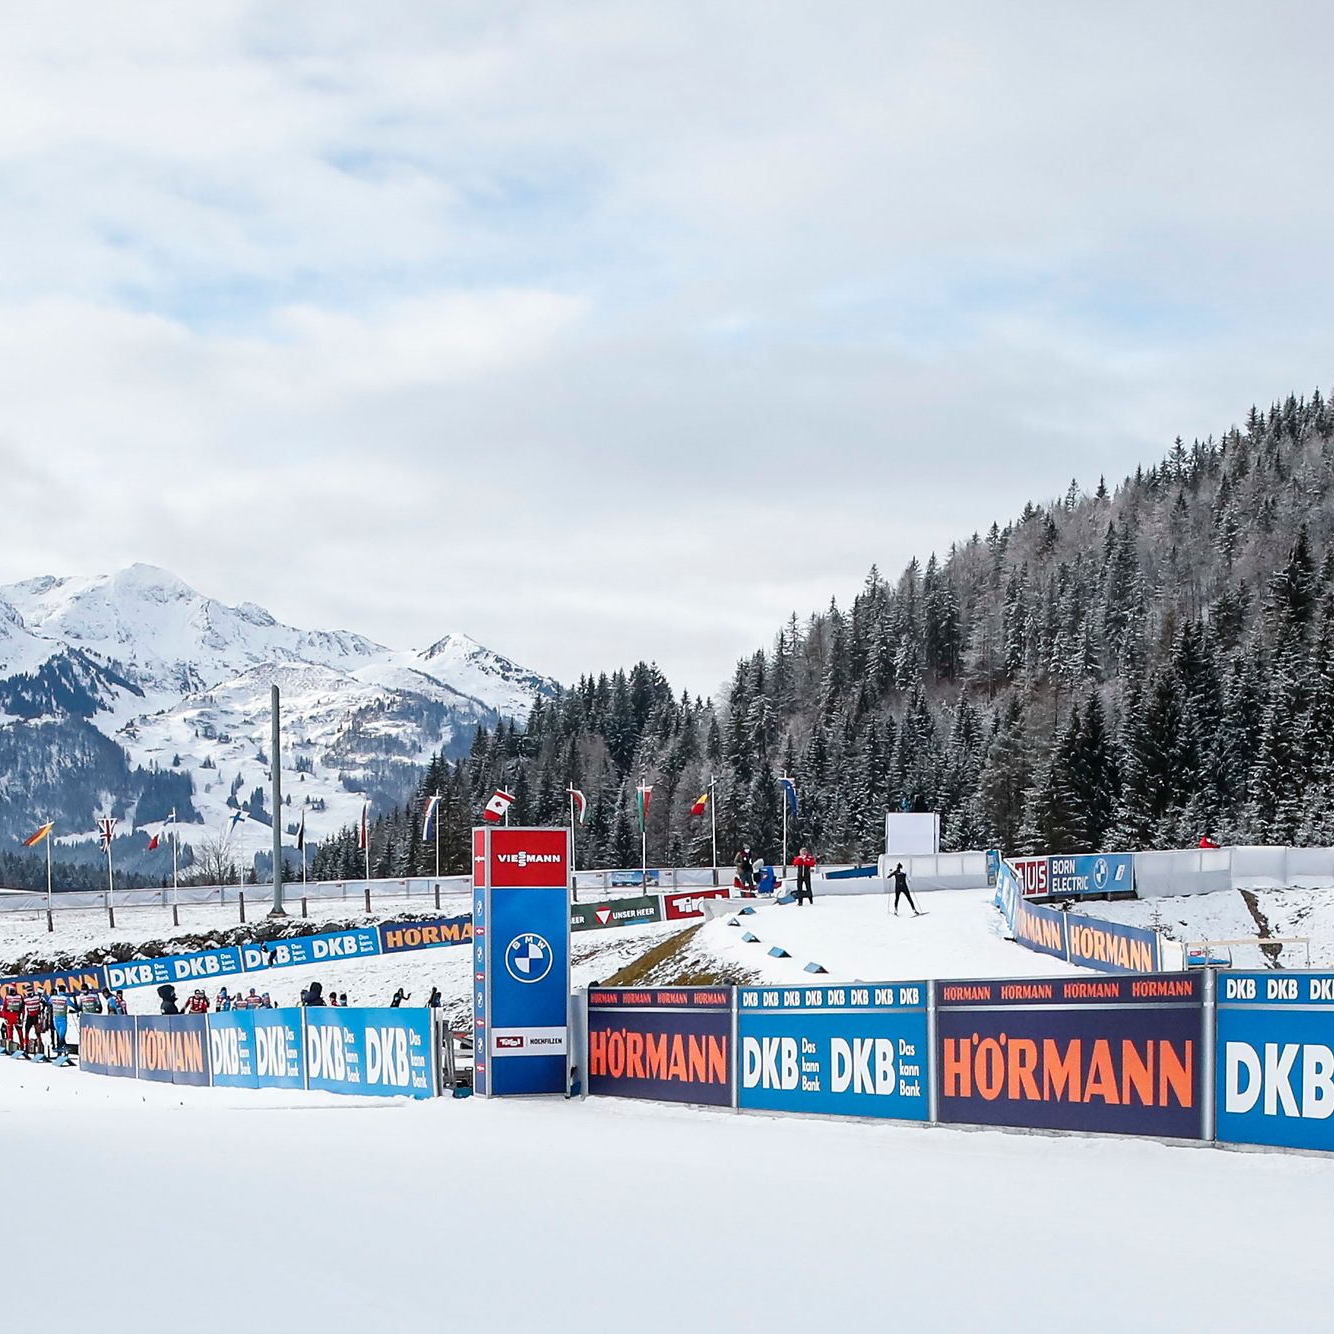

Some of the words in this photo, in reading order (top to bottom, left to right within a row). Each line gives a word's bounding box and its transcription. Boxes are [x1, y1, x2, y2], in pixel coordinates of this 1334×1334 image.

[498, 852, 561, 867] VIESSMANN
[1053, 860, 1075, 875] BORN
[1052, 875, 1089, 893] ELECTRIC
[613, 910, 635, 920] UNSER
[637, 908, 655, 916] HEER
[386, 923, 472, 948] HÖRMA
[512, 936, 547, 950] BMW
[313, 936, 357, 958] DKB
[1070, 925, 1153, 972] HÖRMANN
[109, 965, 153, 987] DKB
[174, 954, 220, 979] DKB
[743, 992, 758, 1007] DKB
[763, 992, 779, 1006] DKB
[784, 991, 800, 1006] DKB
[805, 991, 822, 1006] DKB
[828, 990, 845, 1005] DKB
[851, 990, 868, 1005] DKB
[875, 989, 893, 1005] DKB
[900, 988, 919, 1004] DKB
[944, 986, 990, 1000] HÖRMANN
[1001, 984, 1052, 999] HÖRMANN
[1064, 982, 1118, 998] HÖRMANN
[1133, 980, 1192, 997] HÖRMANN
[1227, 979, 1256, 1000] DKB
[1267, 979, 1298, 1000] DKB
[344, 1027, 354, 1043] Das
[409, 1028, 421, 1046] Das
[81, 1024, 132, 1068] HÖRMANN
[139, 1024, 204, 1073] HÖRMANN
[211, 1028, 238, 1074] DKB
[255, 1026, 286, 1076] DKB
[308, 1025, 345, 1080] DKB
[591, 1028, 726, 1084] HÖRMANN
[802, 1038, 816, 1054] Das
[899, 1039, 915, 1056] Das
[365, 1027, 410, 1086] DKB
[743, 1037, 798, 1090] DKB
[802, 1057, 819, 1073] kann
[831, 1037, 895, 1095] DKB
[347, 1066, 360, 1082] Bank
[899, 1060, 919, 1076] kann
[944, 1032, 1192, 1108] HÖRMANN
[412, 1071, 427, 1088] Bank
[802, 1076, 820, 1092] Bank
[899, 1080, 921, 1097] Bank
